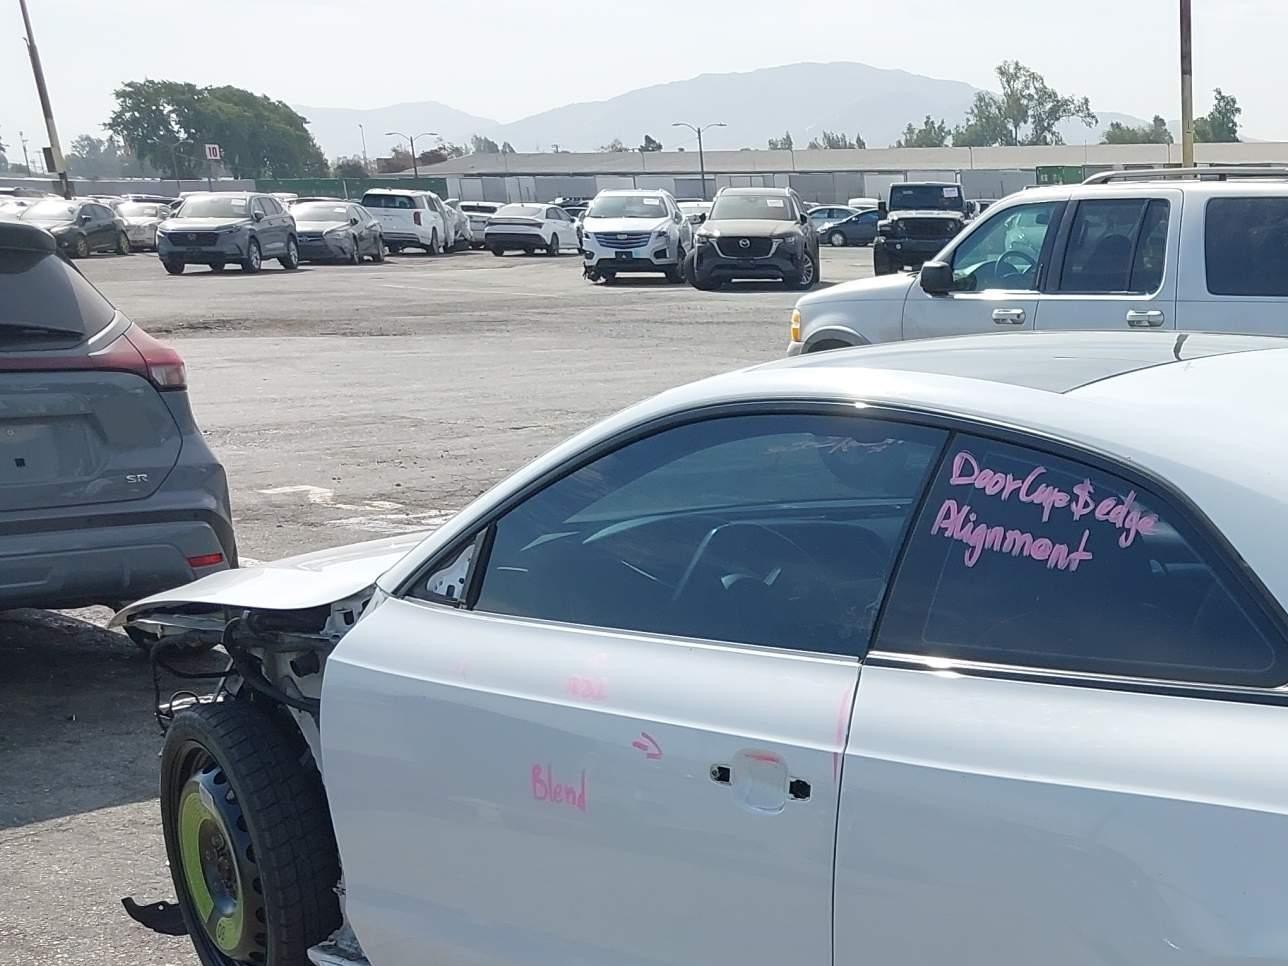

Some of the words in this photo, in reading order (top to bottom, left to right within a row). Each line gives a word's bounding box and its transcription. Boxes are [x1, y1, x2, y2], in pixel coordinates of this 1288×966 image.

[207, 146, 218, 158] 10
[126, 473, 148, 483] SR
[930, 499, 1092, 572] Alignment
[531, 762, 588, 813] Blend
